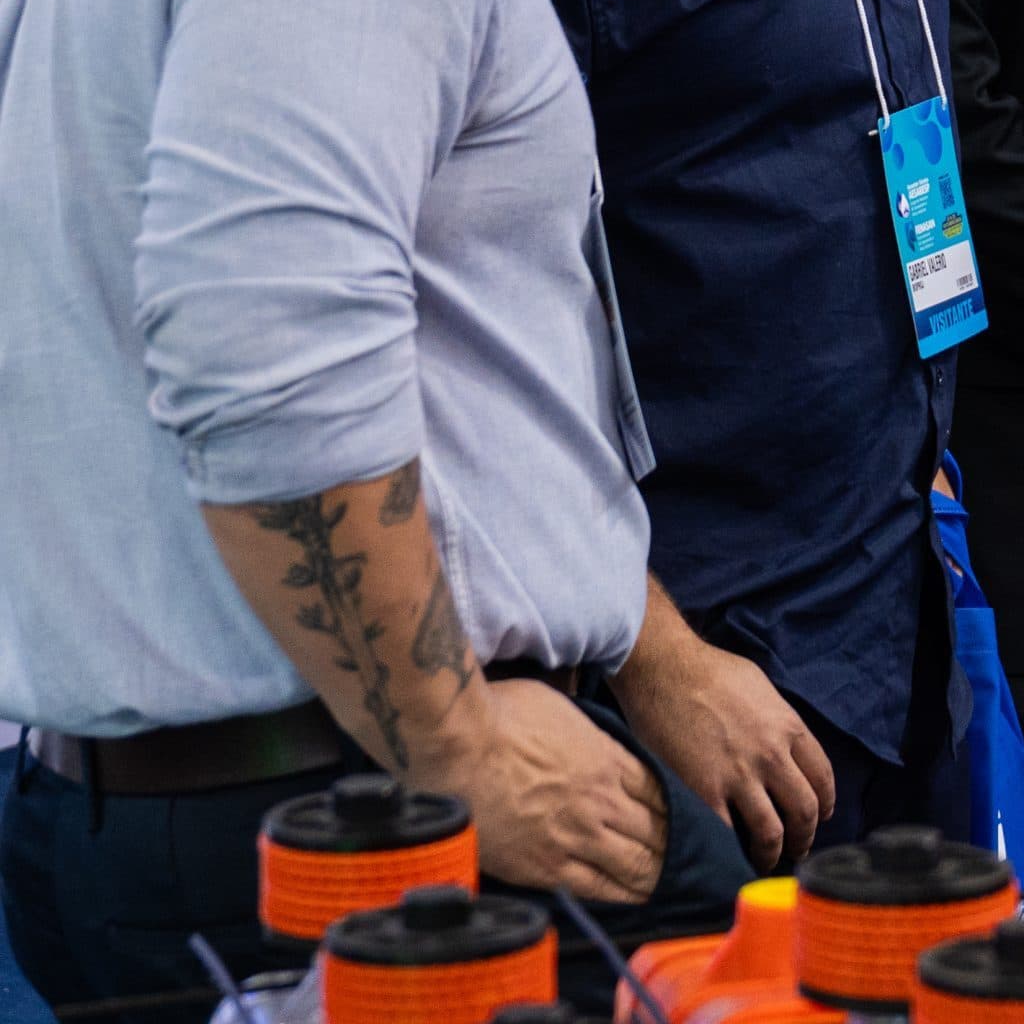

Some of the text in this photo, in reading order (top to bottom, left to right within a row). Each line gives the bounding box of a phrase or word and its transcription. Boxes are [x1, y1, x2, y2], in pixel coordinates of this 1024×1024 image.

[909, 253, 946, 281] GABRIEL VALERIO
[929, 299, 973, 333] VISITANTE
